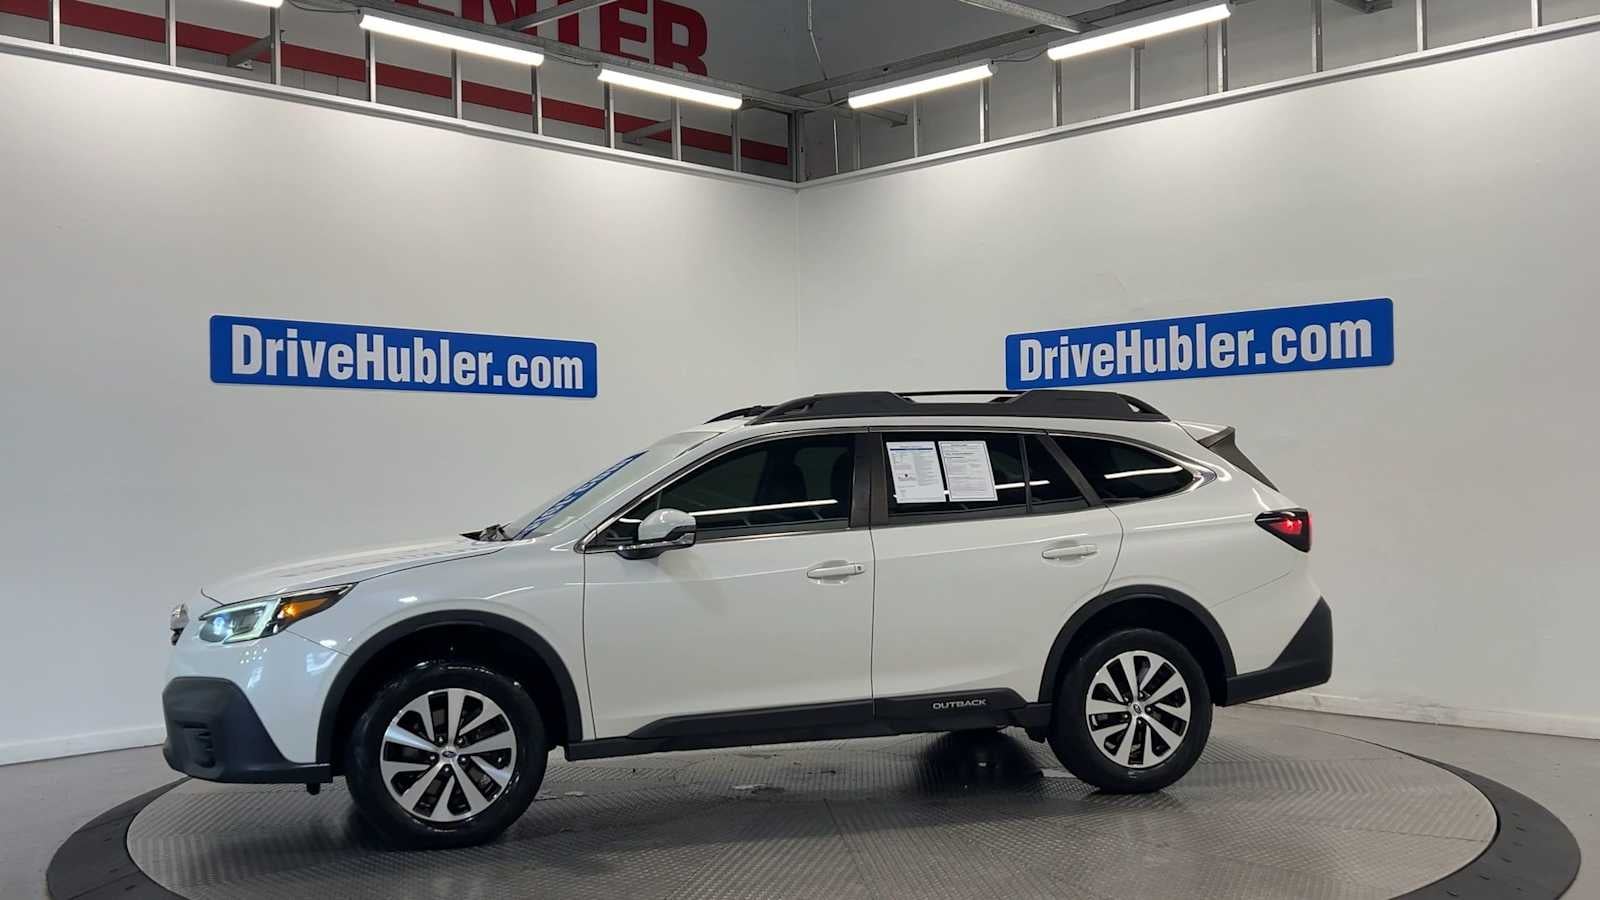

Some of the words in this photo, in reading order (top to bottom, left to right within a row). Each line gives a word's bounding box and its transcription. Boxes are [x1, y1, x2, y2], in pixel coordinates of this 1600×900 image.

[231, 324, 584, 390] DriveHubler.com
[1019, 318, 1373, 382] DriveHubler.com
[932, 699, 987, 710] OUTBACK
